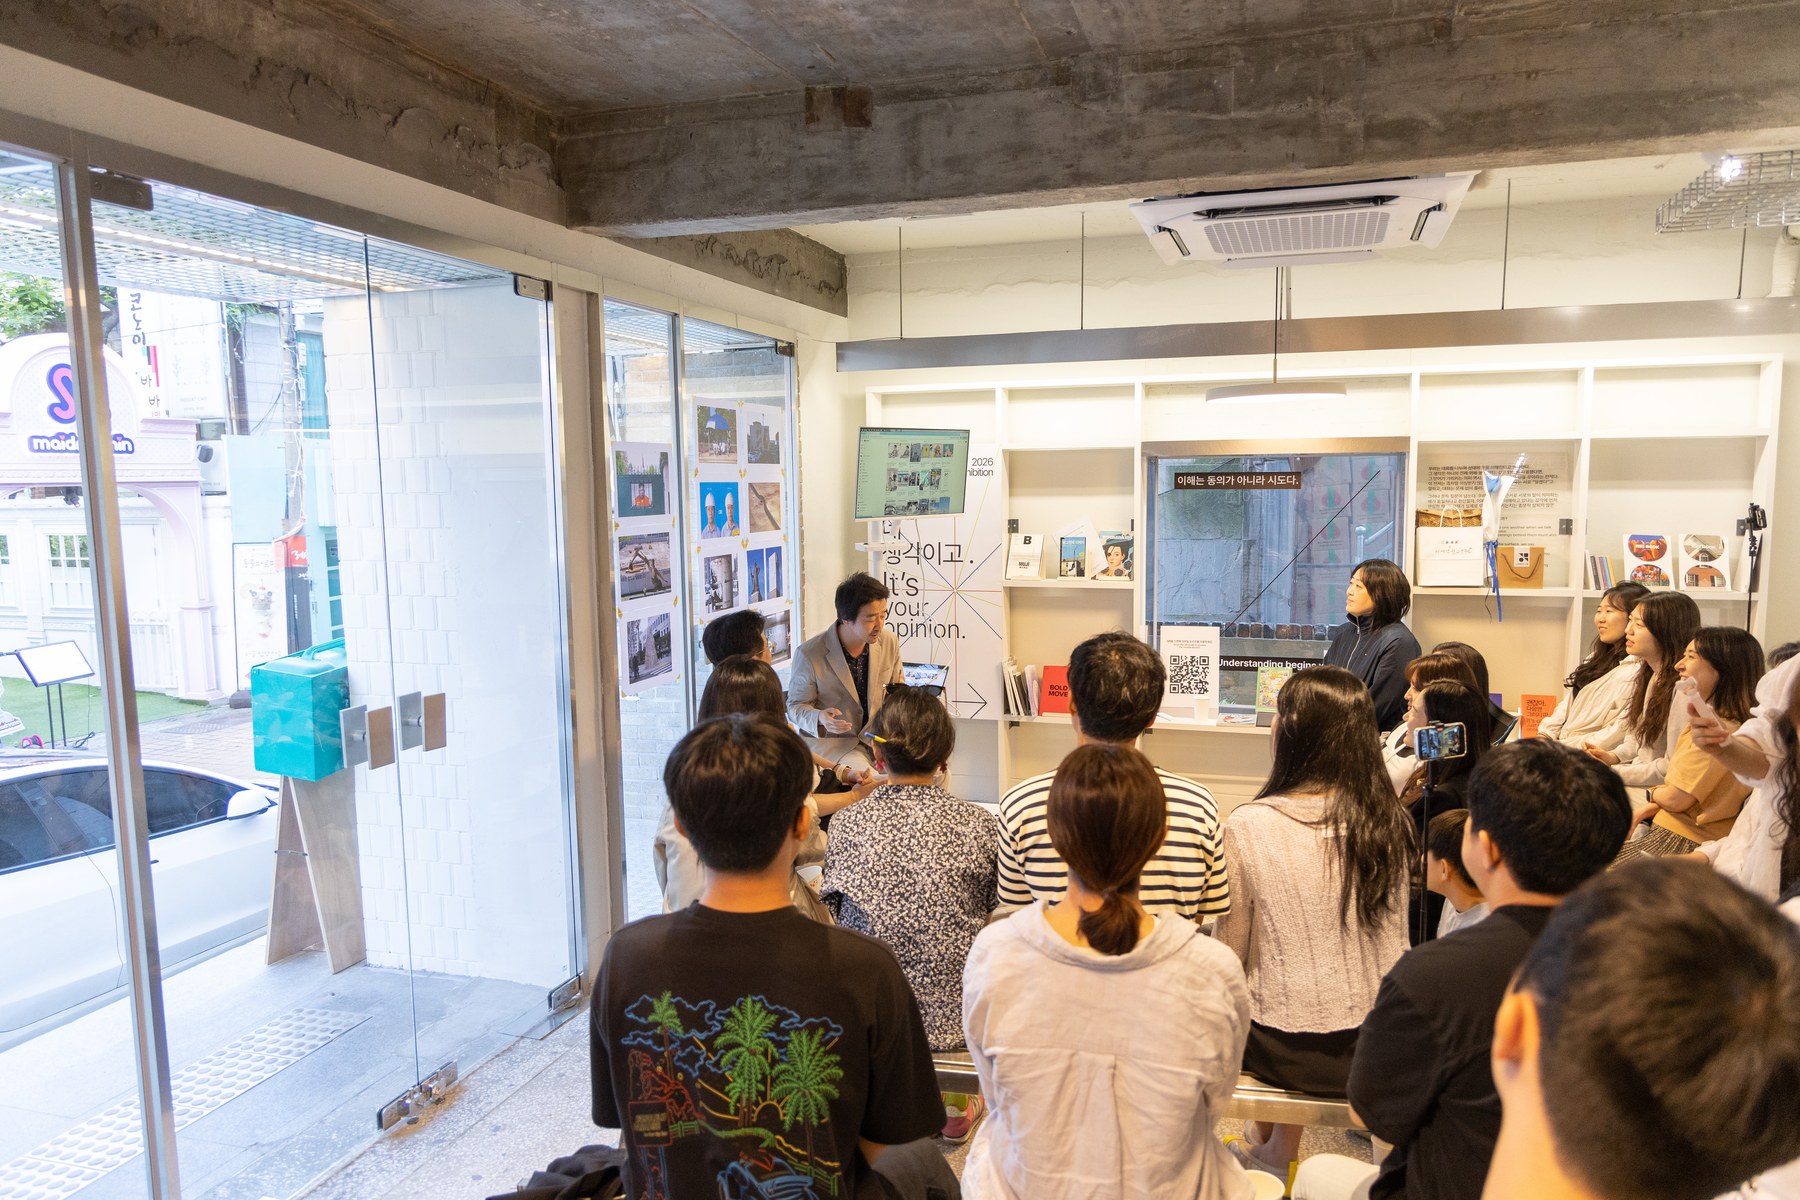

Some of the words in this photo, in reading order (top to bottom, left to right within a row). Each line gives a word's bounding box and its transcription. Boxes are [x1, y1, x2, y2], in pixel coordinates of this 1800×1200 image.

[32, 434, 133, 451] maidin
[971, 457, 994, 467] 2026
[967, 467, 994, 477] ibition
[1177, 475, 1205, 486] 이해는
[1207, 475, 1235, 486] 동의가
[1237, 475, 1266, 486] 아니라
[1267, 475, 1299, 486] 시도다.
[1023, 535, 1033, 545] B
[883, 571, 919, 597] It's
[885, 601, 929, 620] your
[1048, 690, 1069, 698] MOVE
